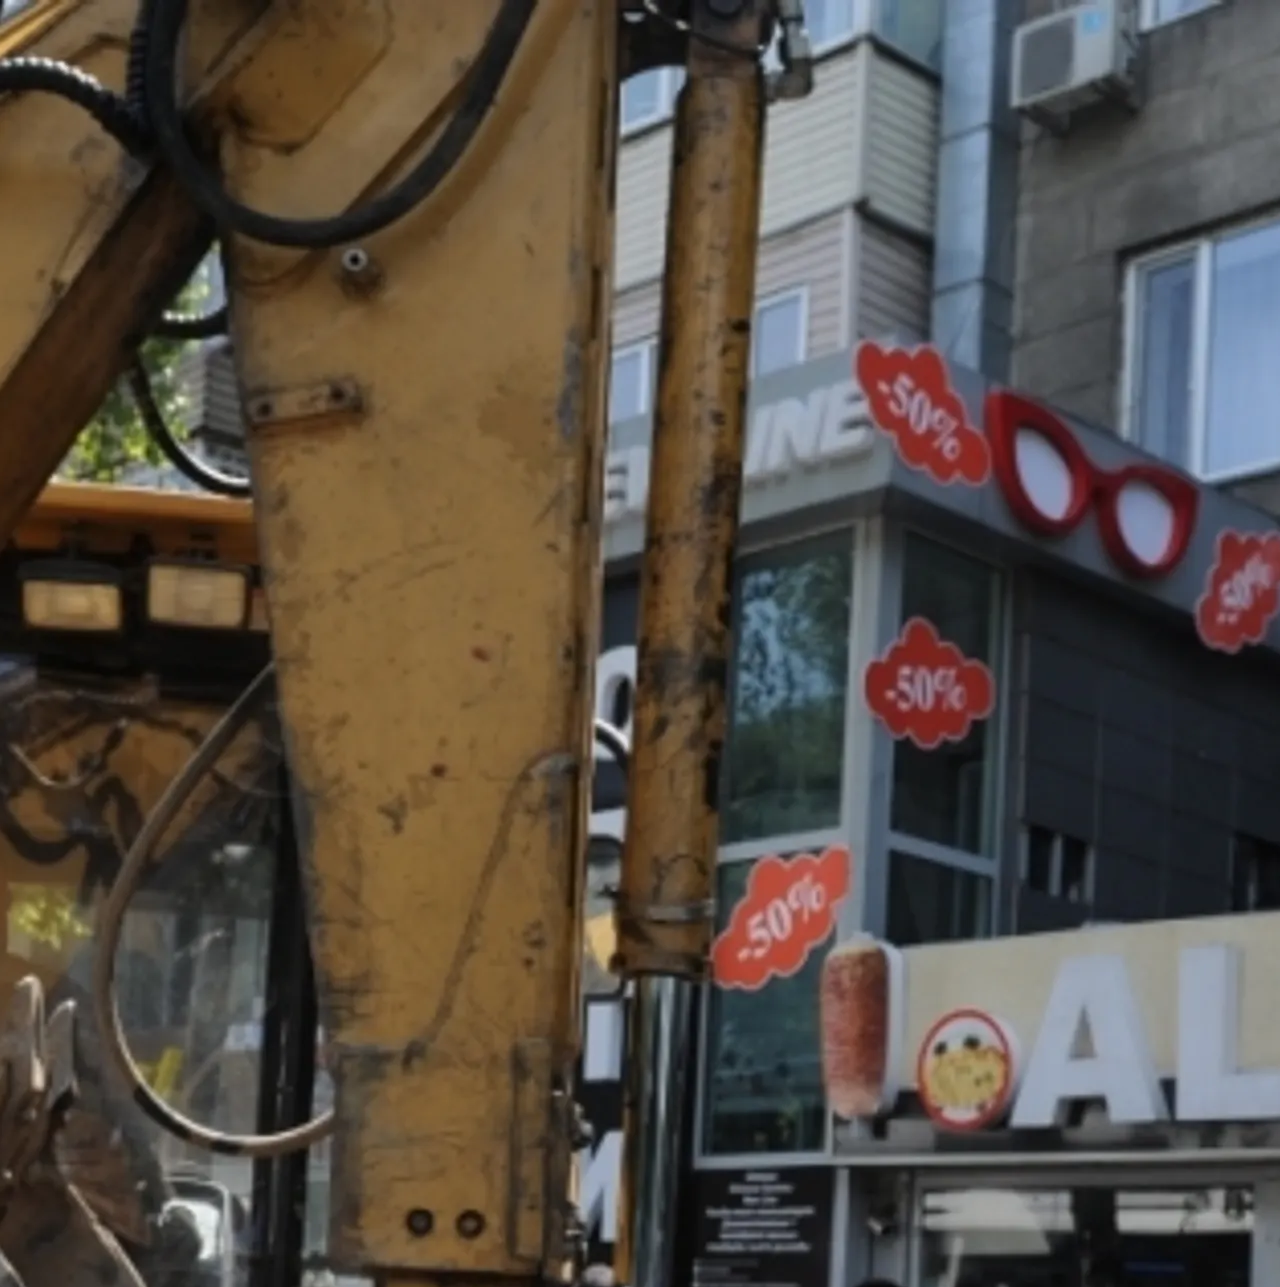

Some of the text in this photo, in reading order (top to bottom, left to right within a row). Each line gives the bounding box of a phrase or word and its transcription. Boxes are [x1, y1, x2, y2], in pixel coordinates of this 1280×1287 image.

[744, 377, 874, 479] INE
[877, 371, 962, 462] -50%
[884, 664, 967, 712] -50%
[738, 872, 826, 961] -50%
